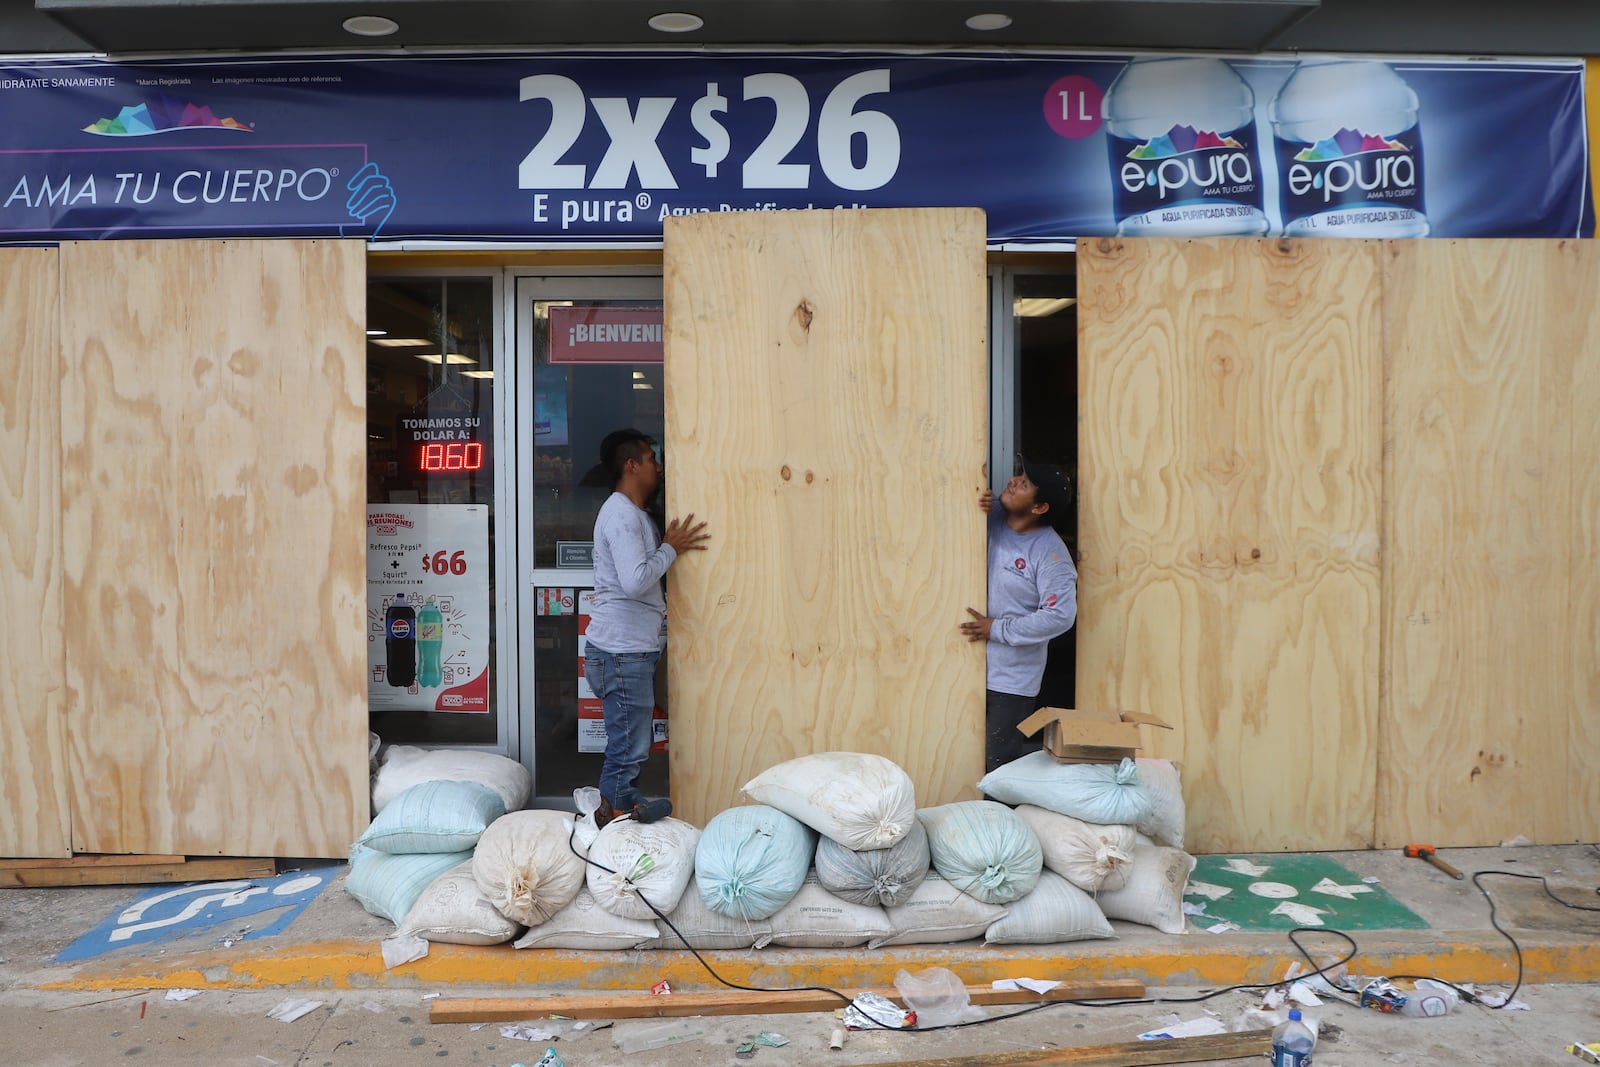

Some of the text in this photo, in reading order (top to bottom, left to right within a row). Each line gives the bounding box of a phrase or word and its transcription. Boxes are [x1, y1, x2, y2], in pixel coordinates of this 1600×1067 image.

[52, 78, 115, 87] SANAMENTE
[1059, 91, 1092, 120] 1 L
[3, 174, 97, 208] AMA
[114, 172, 161, 204] TU
[1203, 188, 1221, 196] AMA
[533, 194, 549, 222] E
[1162, 212, 1182, 222] AGUA
[1183, 209, 1225, 221] PURIFICADA
[1226, 208, 1237, 217] SIN
[1327, 216, 1345, 226] AGUA
[1347, 213, 1388, 224] PURIFICADA
[1389, 212, 1399, 221] SIN
[403, 417, 480, 429] TOMAMOS SU
[413, 430, 470, 440] DOLAR A:
[422, 550, 467, 576] $66
